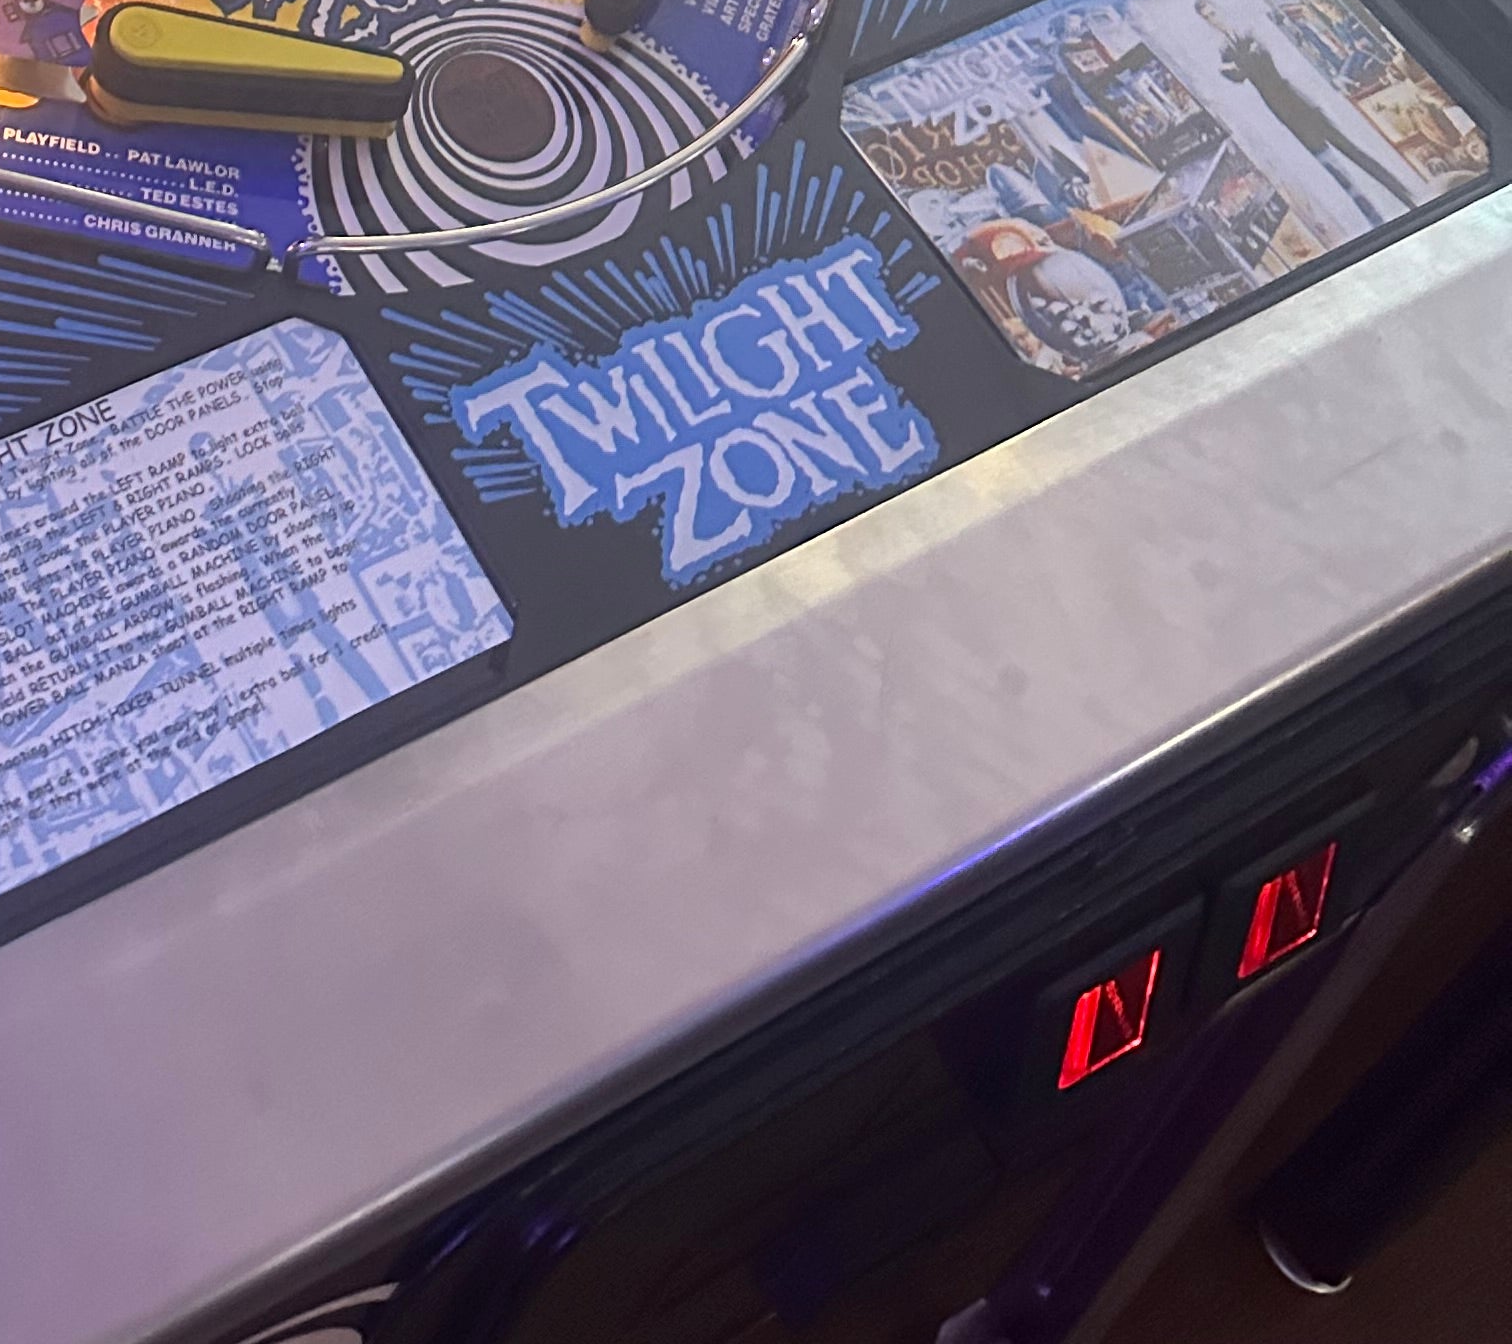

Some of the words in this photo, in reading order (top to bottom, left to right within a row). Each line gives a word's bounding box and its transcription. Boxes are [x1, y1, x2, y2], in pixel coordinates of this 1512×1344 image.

[3, 127, 101, 157] PLAYFIELD
[127, 149, 162, 166] PAT
[163, 156, 241, 180] LAWLOR
[140, 187, 177, 204] TED
[179, 192, 239, 216] ESTES
[188, 178, 240, 198] L.E.D.
[83, 213, 142, 237] CHRIS
[462, 246, 908, 518] TWILIGHT
[37, 398, 117, 447] ZONE
[612, 362, 927, 574] ZONE
[100, 503, 155, 536] PLAYER
